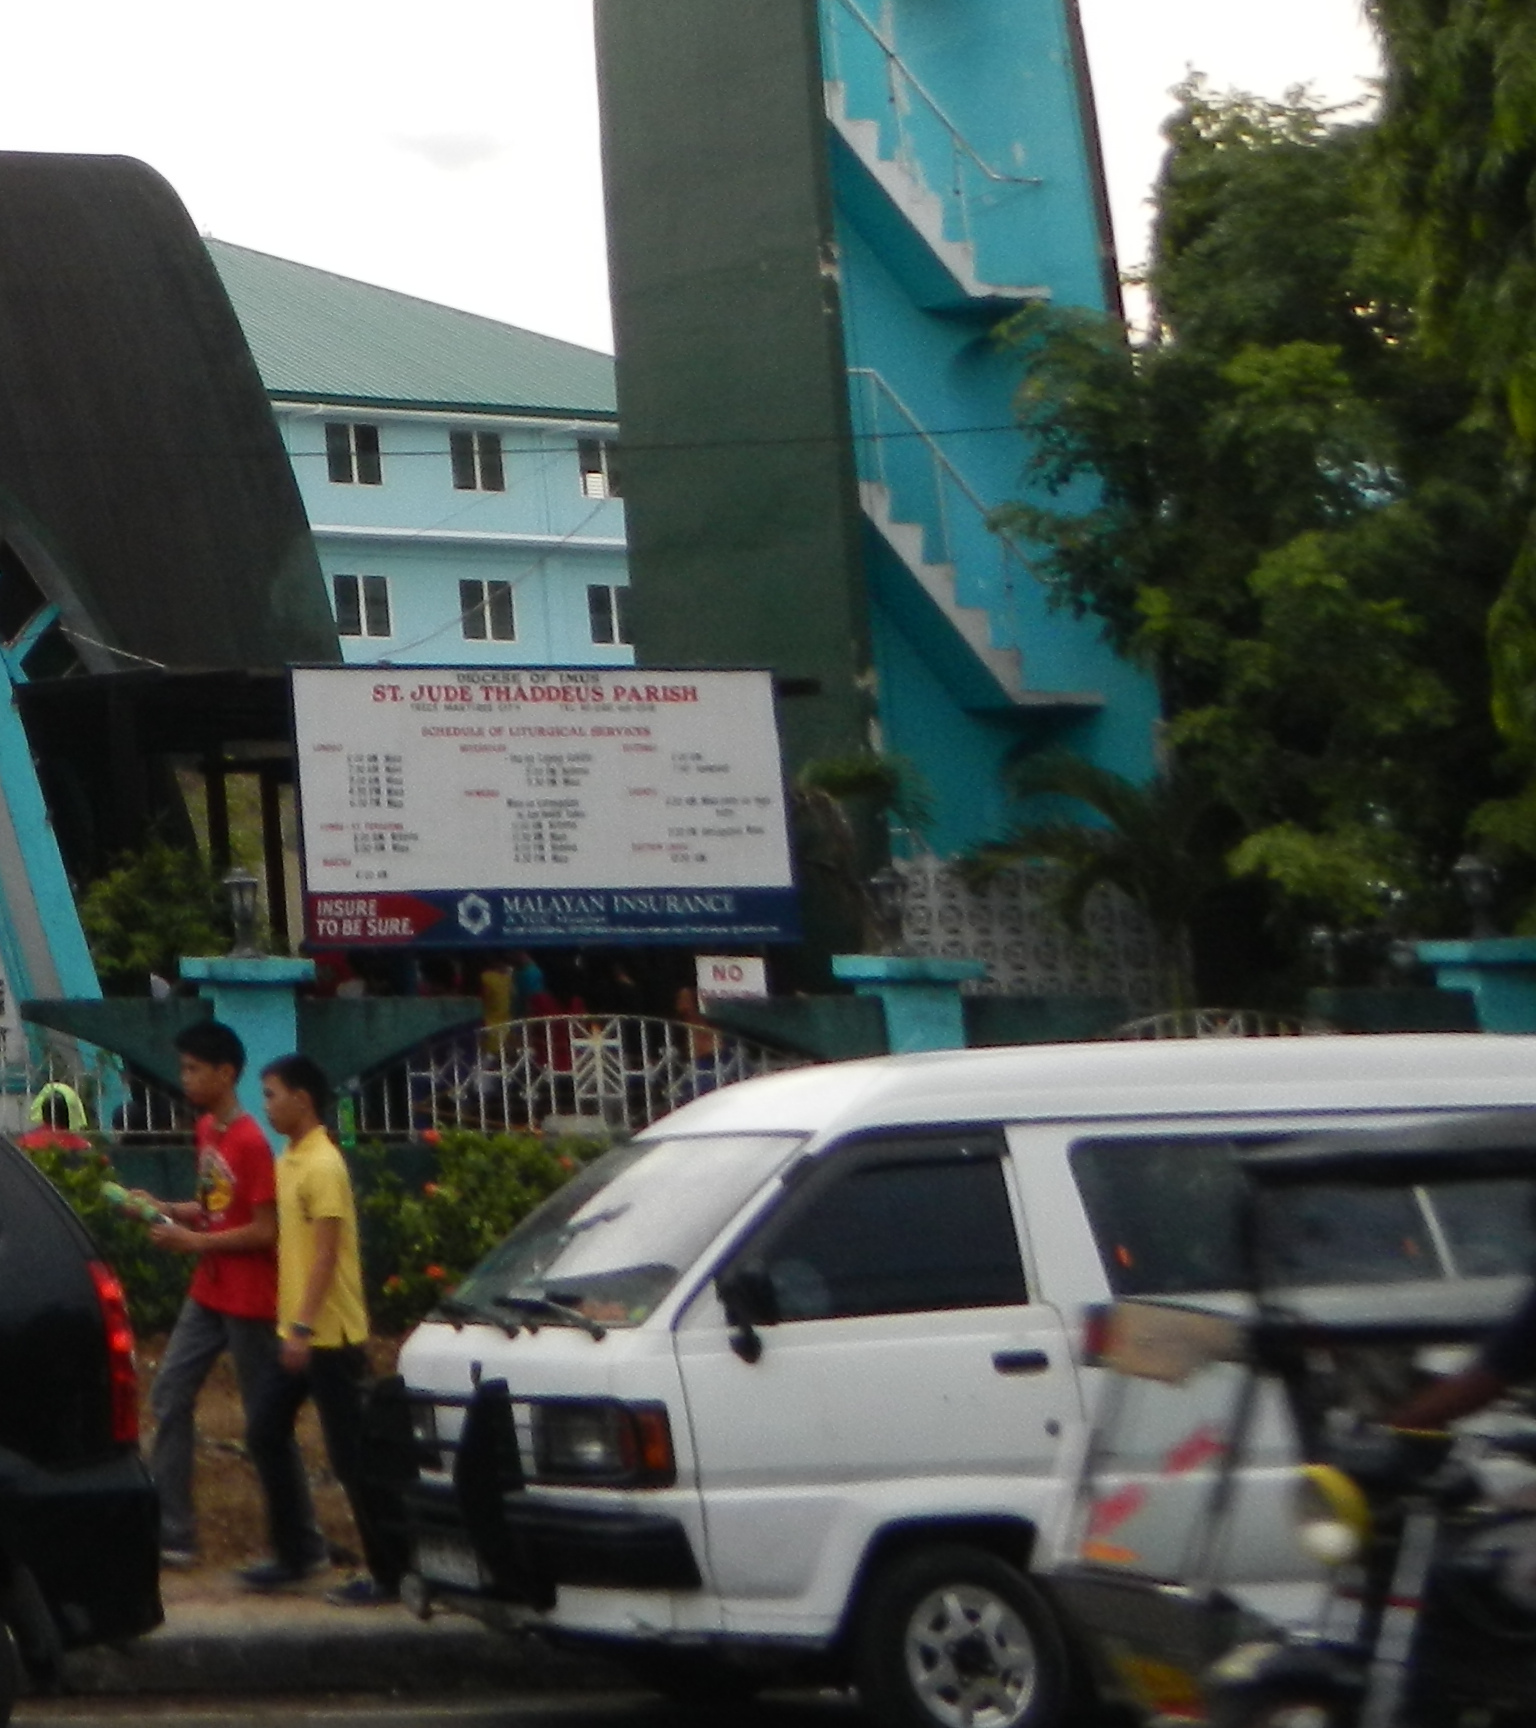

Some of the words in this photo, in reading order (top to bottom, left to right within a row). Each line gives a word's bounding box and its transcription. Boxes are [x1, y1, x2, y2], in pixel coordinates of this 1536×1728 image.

[456, 672, 521, 684] DIOCESE
[529, 673, 548, 684] OF
[371, 684, 404, 703] ST.
[410, 684, 473, 703] JUDE
[480, 684, 605, 703] THADDEUS
[613, 685, 699, 703] PARISH
[421, 726, 485, 738] SCHEDULE
[488, 726, 503, 737] OF
[508, 726, 585, 738] LITURGICAL
[590, 726, 652, 737] SERVICES
[316, 899, 378, 917] INSURE
[502, 895, 607, 913] MALAYAN
[612, 894, 736, 913] INSURANCE
[315, 919, 339, 937] TO
[342, 919, 363, 936] BE
[367, 917, 415, 936] SURE.
[712, 963, 744, 982] NO
